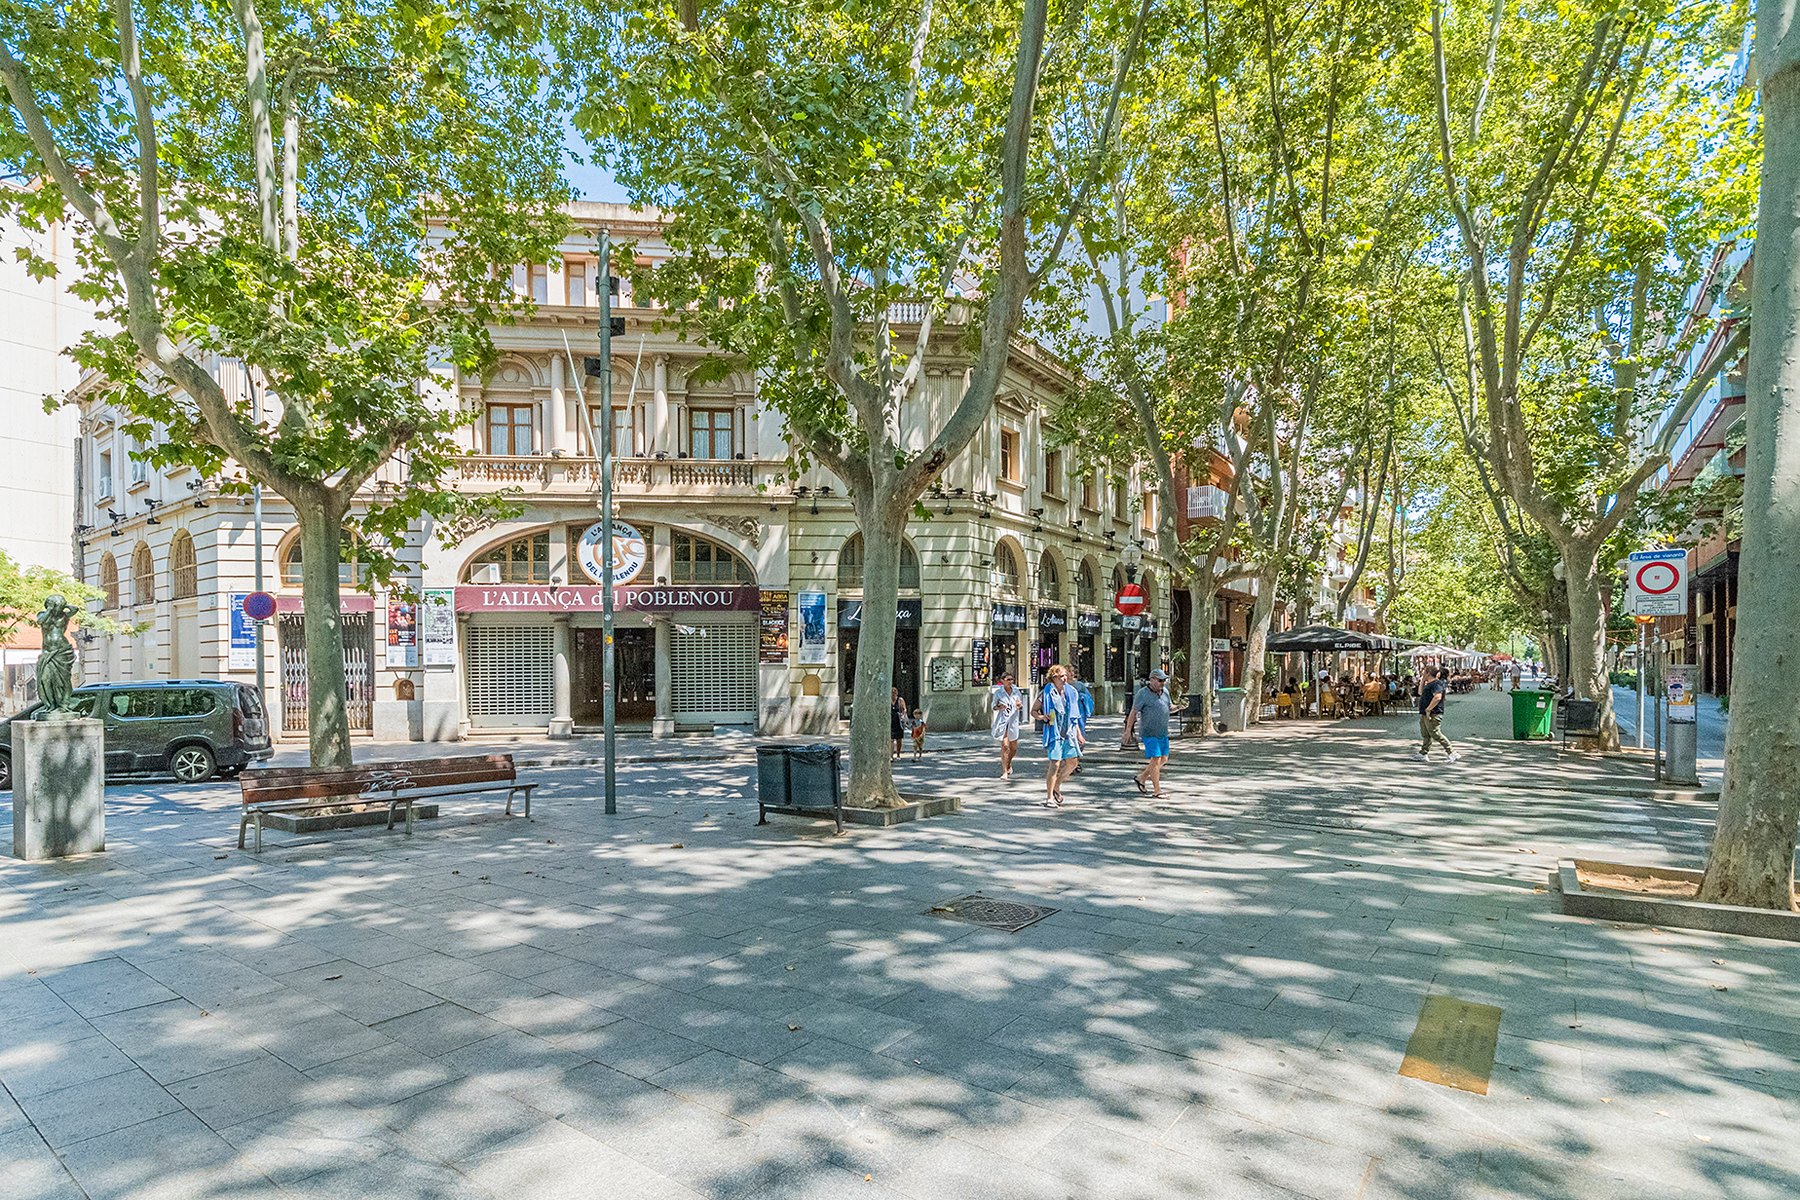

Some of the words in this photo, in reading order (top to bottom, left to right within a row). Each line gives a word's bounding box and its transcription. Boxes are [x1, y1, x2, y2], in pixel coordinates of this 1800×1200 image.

[591, 523, 633, 537] L'AANÇA
[586, 561, 598, 576] DEL
[482, 591, 585, 610] L'ALIANÇA
[591, 590, 619, 606] dl
[625, 591, 734, 606] POBLENOU
